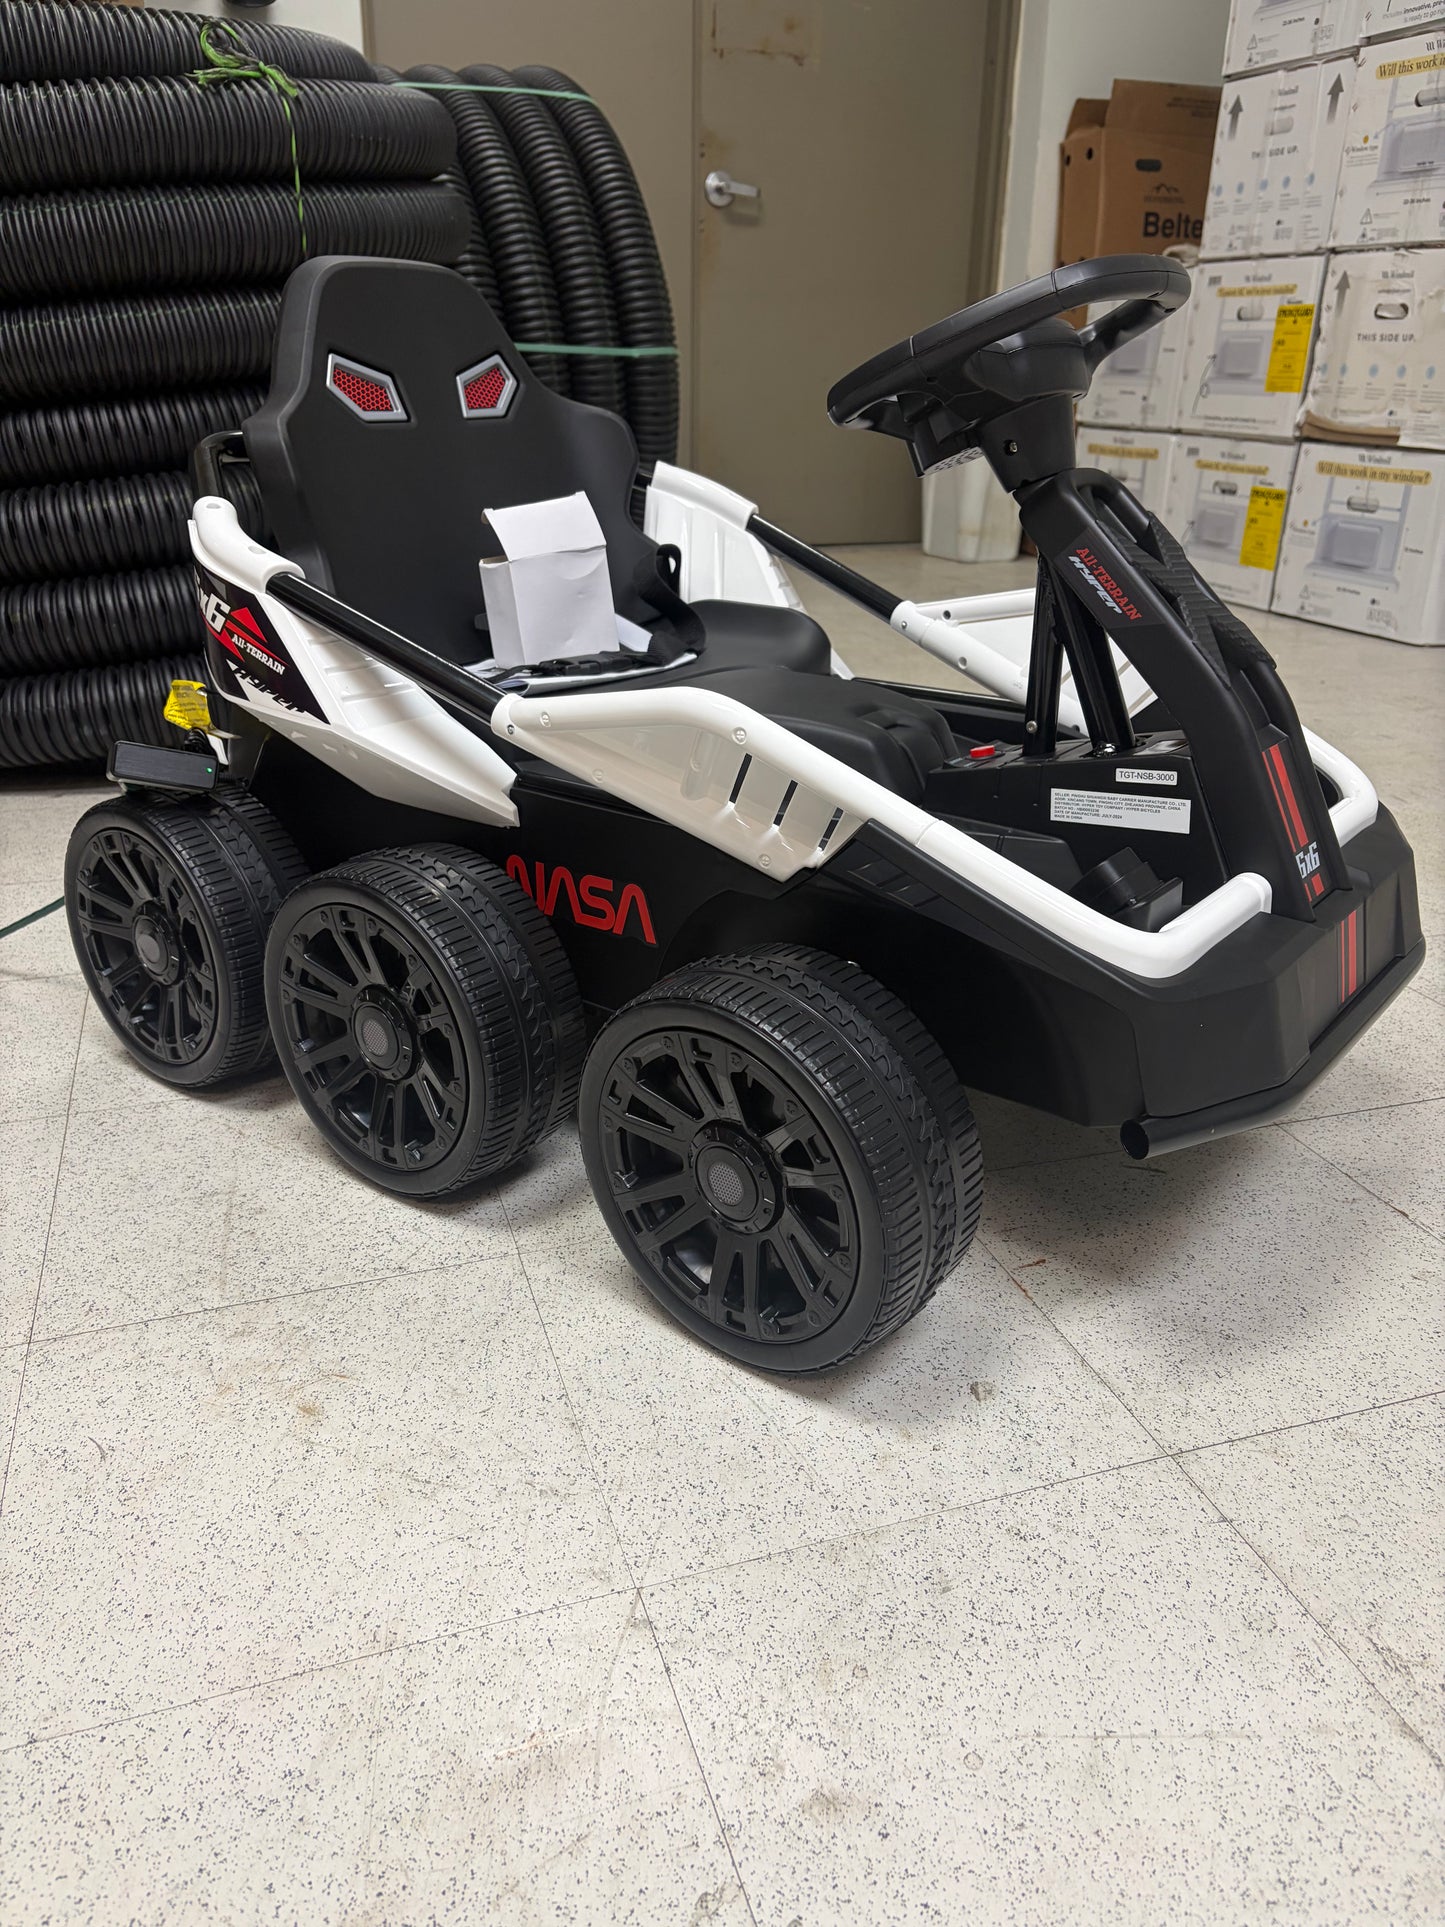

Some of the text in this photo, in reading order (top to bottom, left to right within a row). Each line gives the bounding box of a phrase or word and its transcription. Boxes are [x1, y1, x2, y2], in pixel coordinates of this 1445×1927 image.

[1379, 62, 1397, 78] Will
[1398, 60, 1413, 74] this
[1416, 54, 1437, 70] work
[1357, 333, 1416, 342] THIS SIDE UP.
[1318, 461, 1430, 485] Will this work in my window?
[1076, 548, 1142, 620] All-TERRAIN
[231, 633, 285, 676] All-TERRAIN
[1119, 771, 1175, 782] TGT-NSB-3000
[1295, 841, 1320, 879] 6x6
[506, 854, 657, 945] NASA
